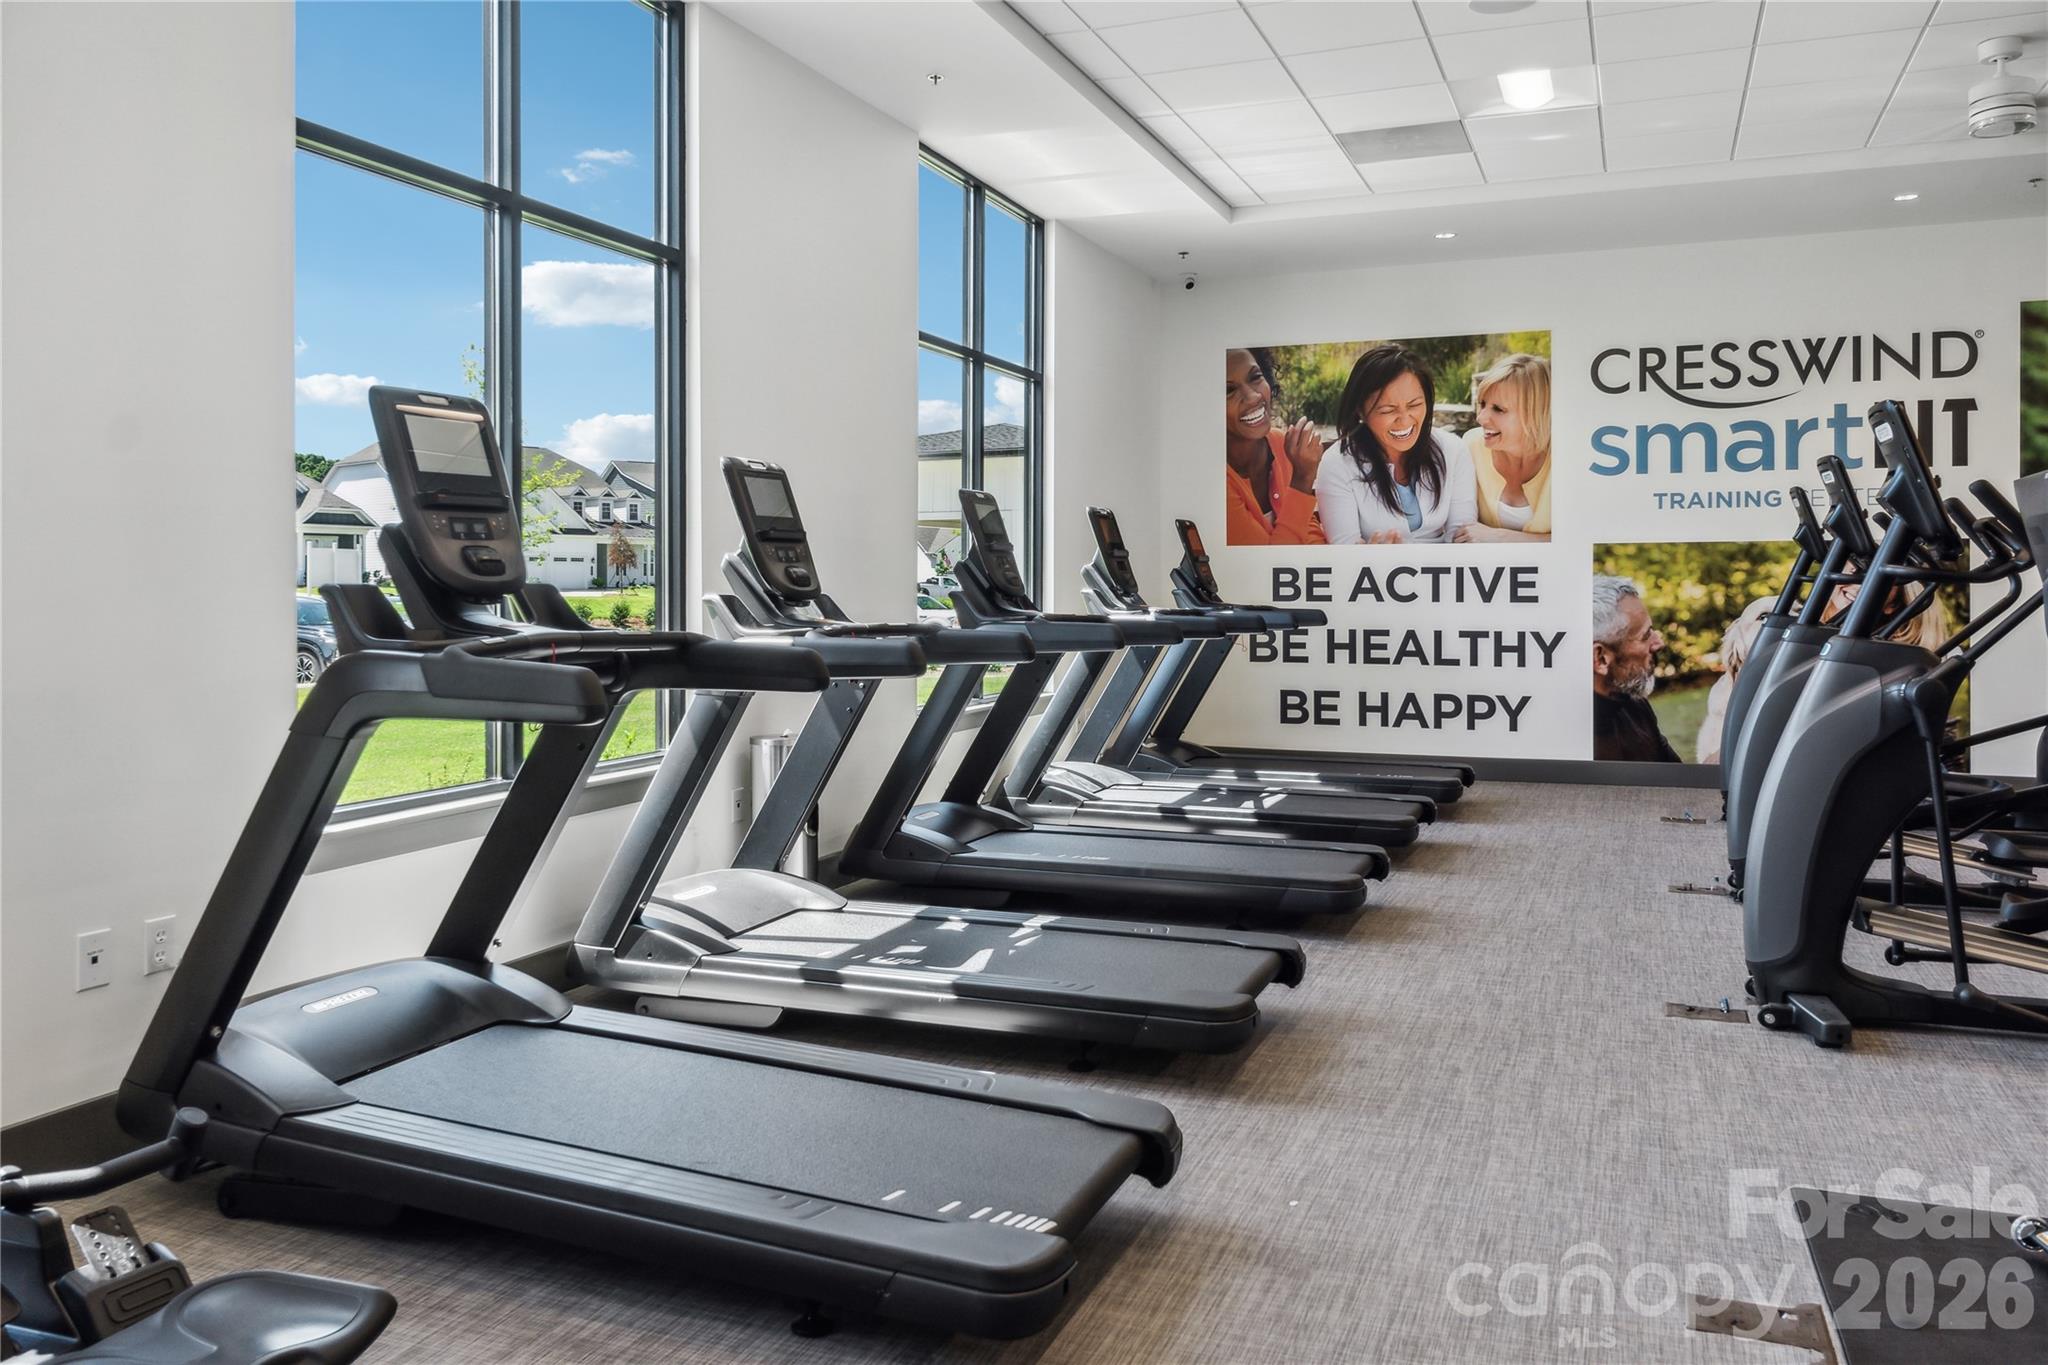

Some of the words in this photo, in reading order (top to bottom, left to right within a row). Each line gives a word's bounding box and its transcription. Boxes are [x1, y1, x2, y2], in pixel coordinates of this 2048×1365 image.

[1589, 398, 1979, 476] smartIT
[1653, 490, 1782, 509] TRAINING
[1272, 567, 1332, 602] BE
[1348, 566, 1539, 603] ACTIVE
[1250, 629, 1309, 663] BE
[1327, 629, 1567, 668] HEALTHY
[1280, 689, 1340, 726] BE
[1358, 691, 1532, 732] HAPPY
